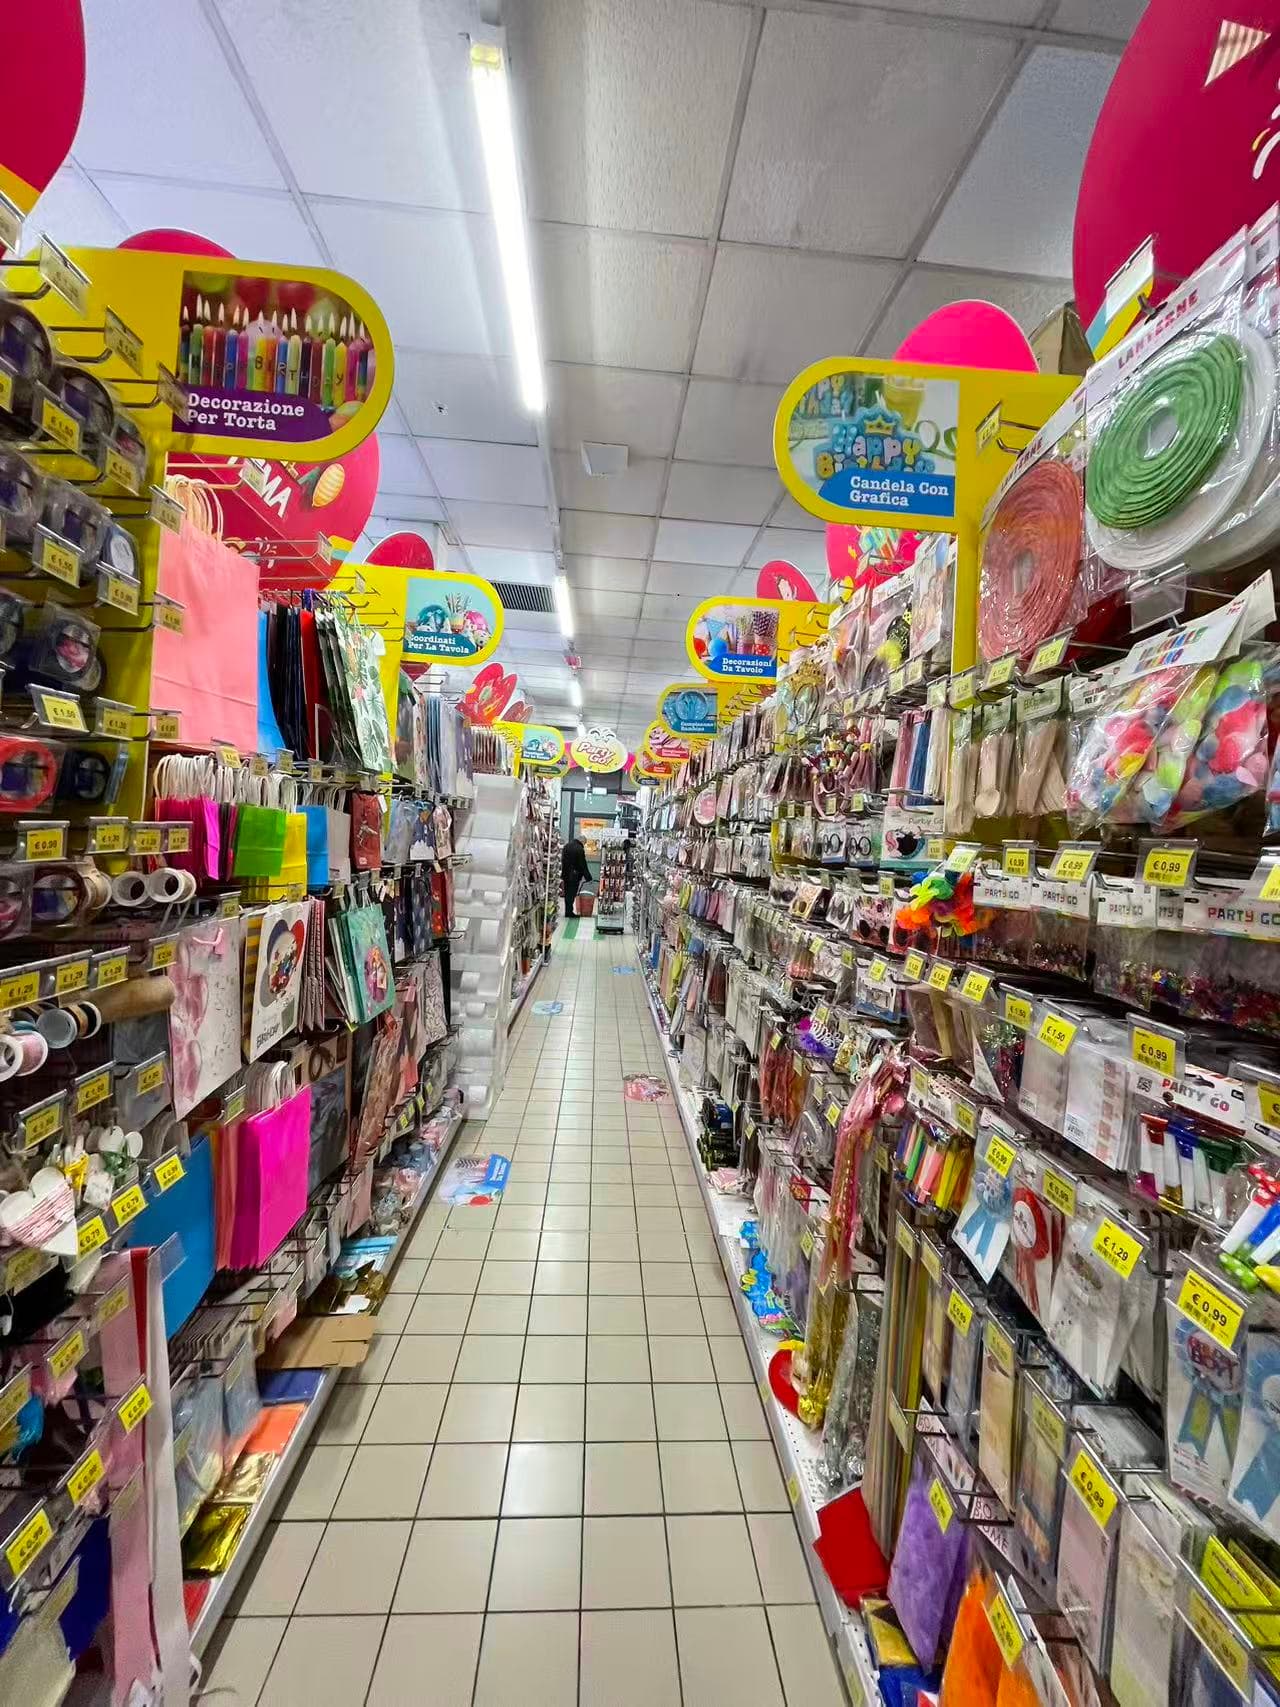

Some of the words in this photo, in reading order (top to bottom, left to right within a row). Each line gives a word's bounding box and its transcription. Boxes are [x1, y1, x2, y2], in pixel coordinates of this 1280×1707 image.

[187, 392, 305, 417] Decorazione
[187, 409, 218, 425] Per
[223, 411, 277, 431] Torta
[850, 476, 916, 494] Candela
[918, 481, 949, 496] Con
[849, 489, 910, 507] Grafica
[408, 641, 424, 650] Per
[426, 642, 437, 651] La
[438, 644, 470, 654] Tavola
[722, 657, 772, 668] Decorazioni
[735, 665, 764, 674] Tavolo
[578, 741, 616, 759] Party
[588, 752, 613, 765] Go!
[984, 888, 1008, 898] PARTY
[1008, 891, 1019, 899] GO
[1042, 890, 1065, 903] PARTY
[1067, 895, 1078, 905] GO
[1207, 907, 1254, 923] PARTY
[1161, 1078, 1206, 1102] PARTY
[1209, 1096, 1230, 1112] GO
